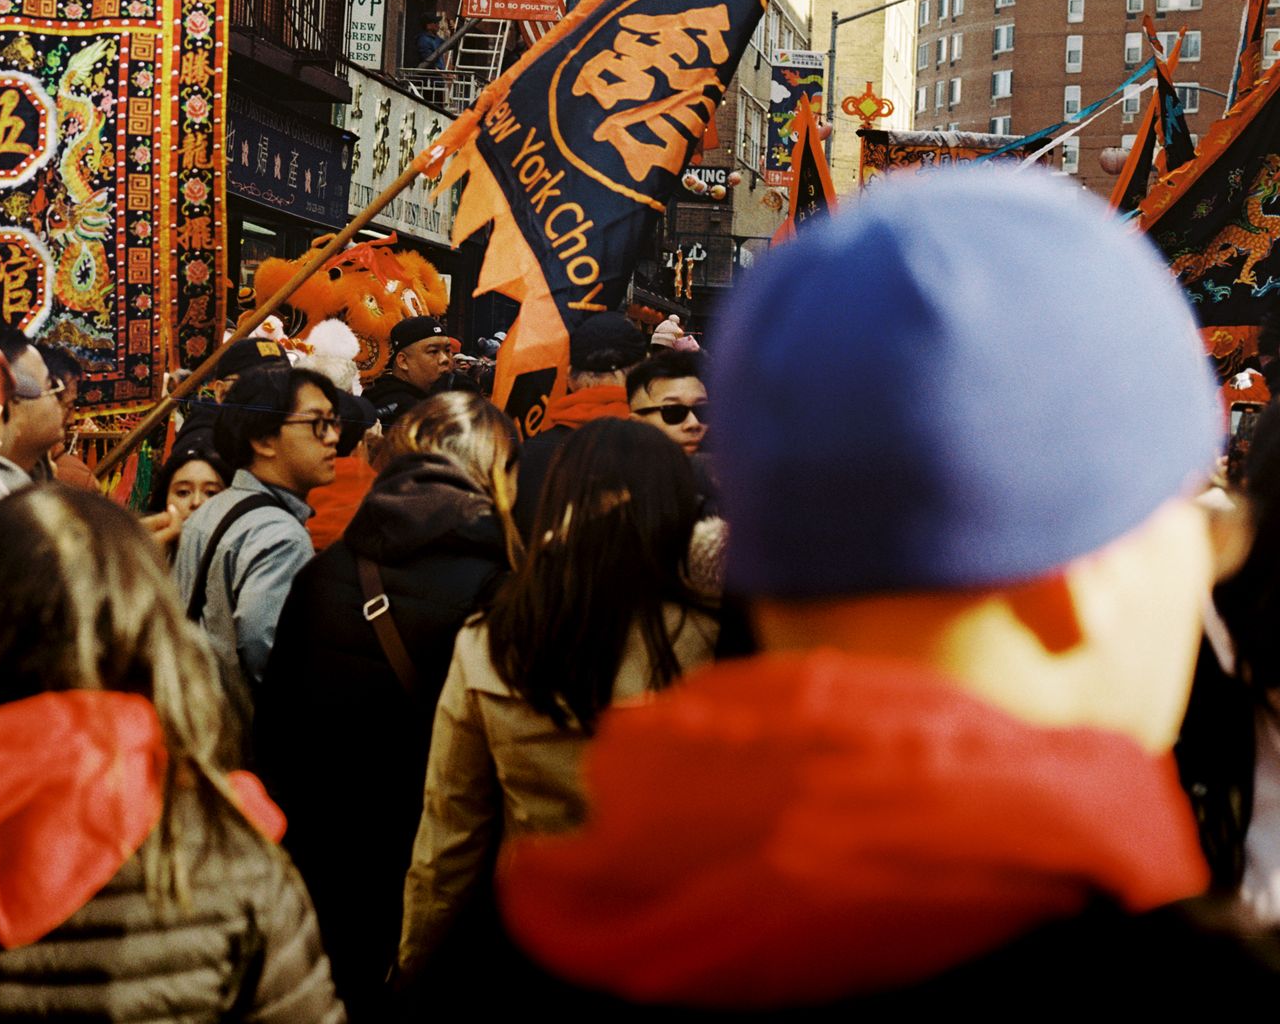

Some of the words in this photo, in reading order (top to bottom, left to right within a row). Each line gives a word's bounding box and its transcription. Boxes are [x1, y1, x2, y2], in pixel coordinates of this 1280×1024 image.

[351, 21, 376, 31] NEW
[356, 42, 371, 51] BO
[484, 102, 521, 144] ew
[511, 127, 566, 214] York
